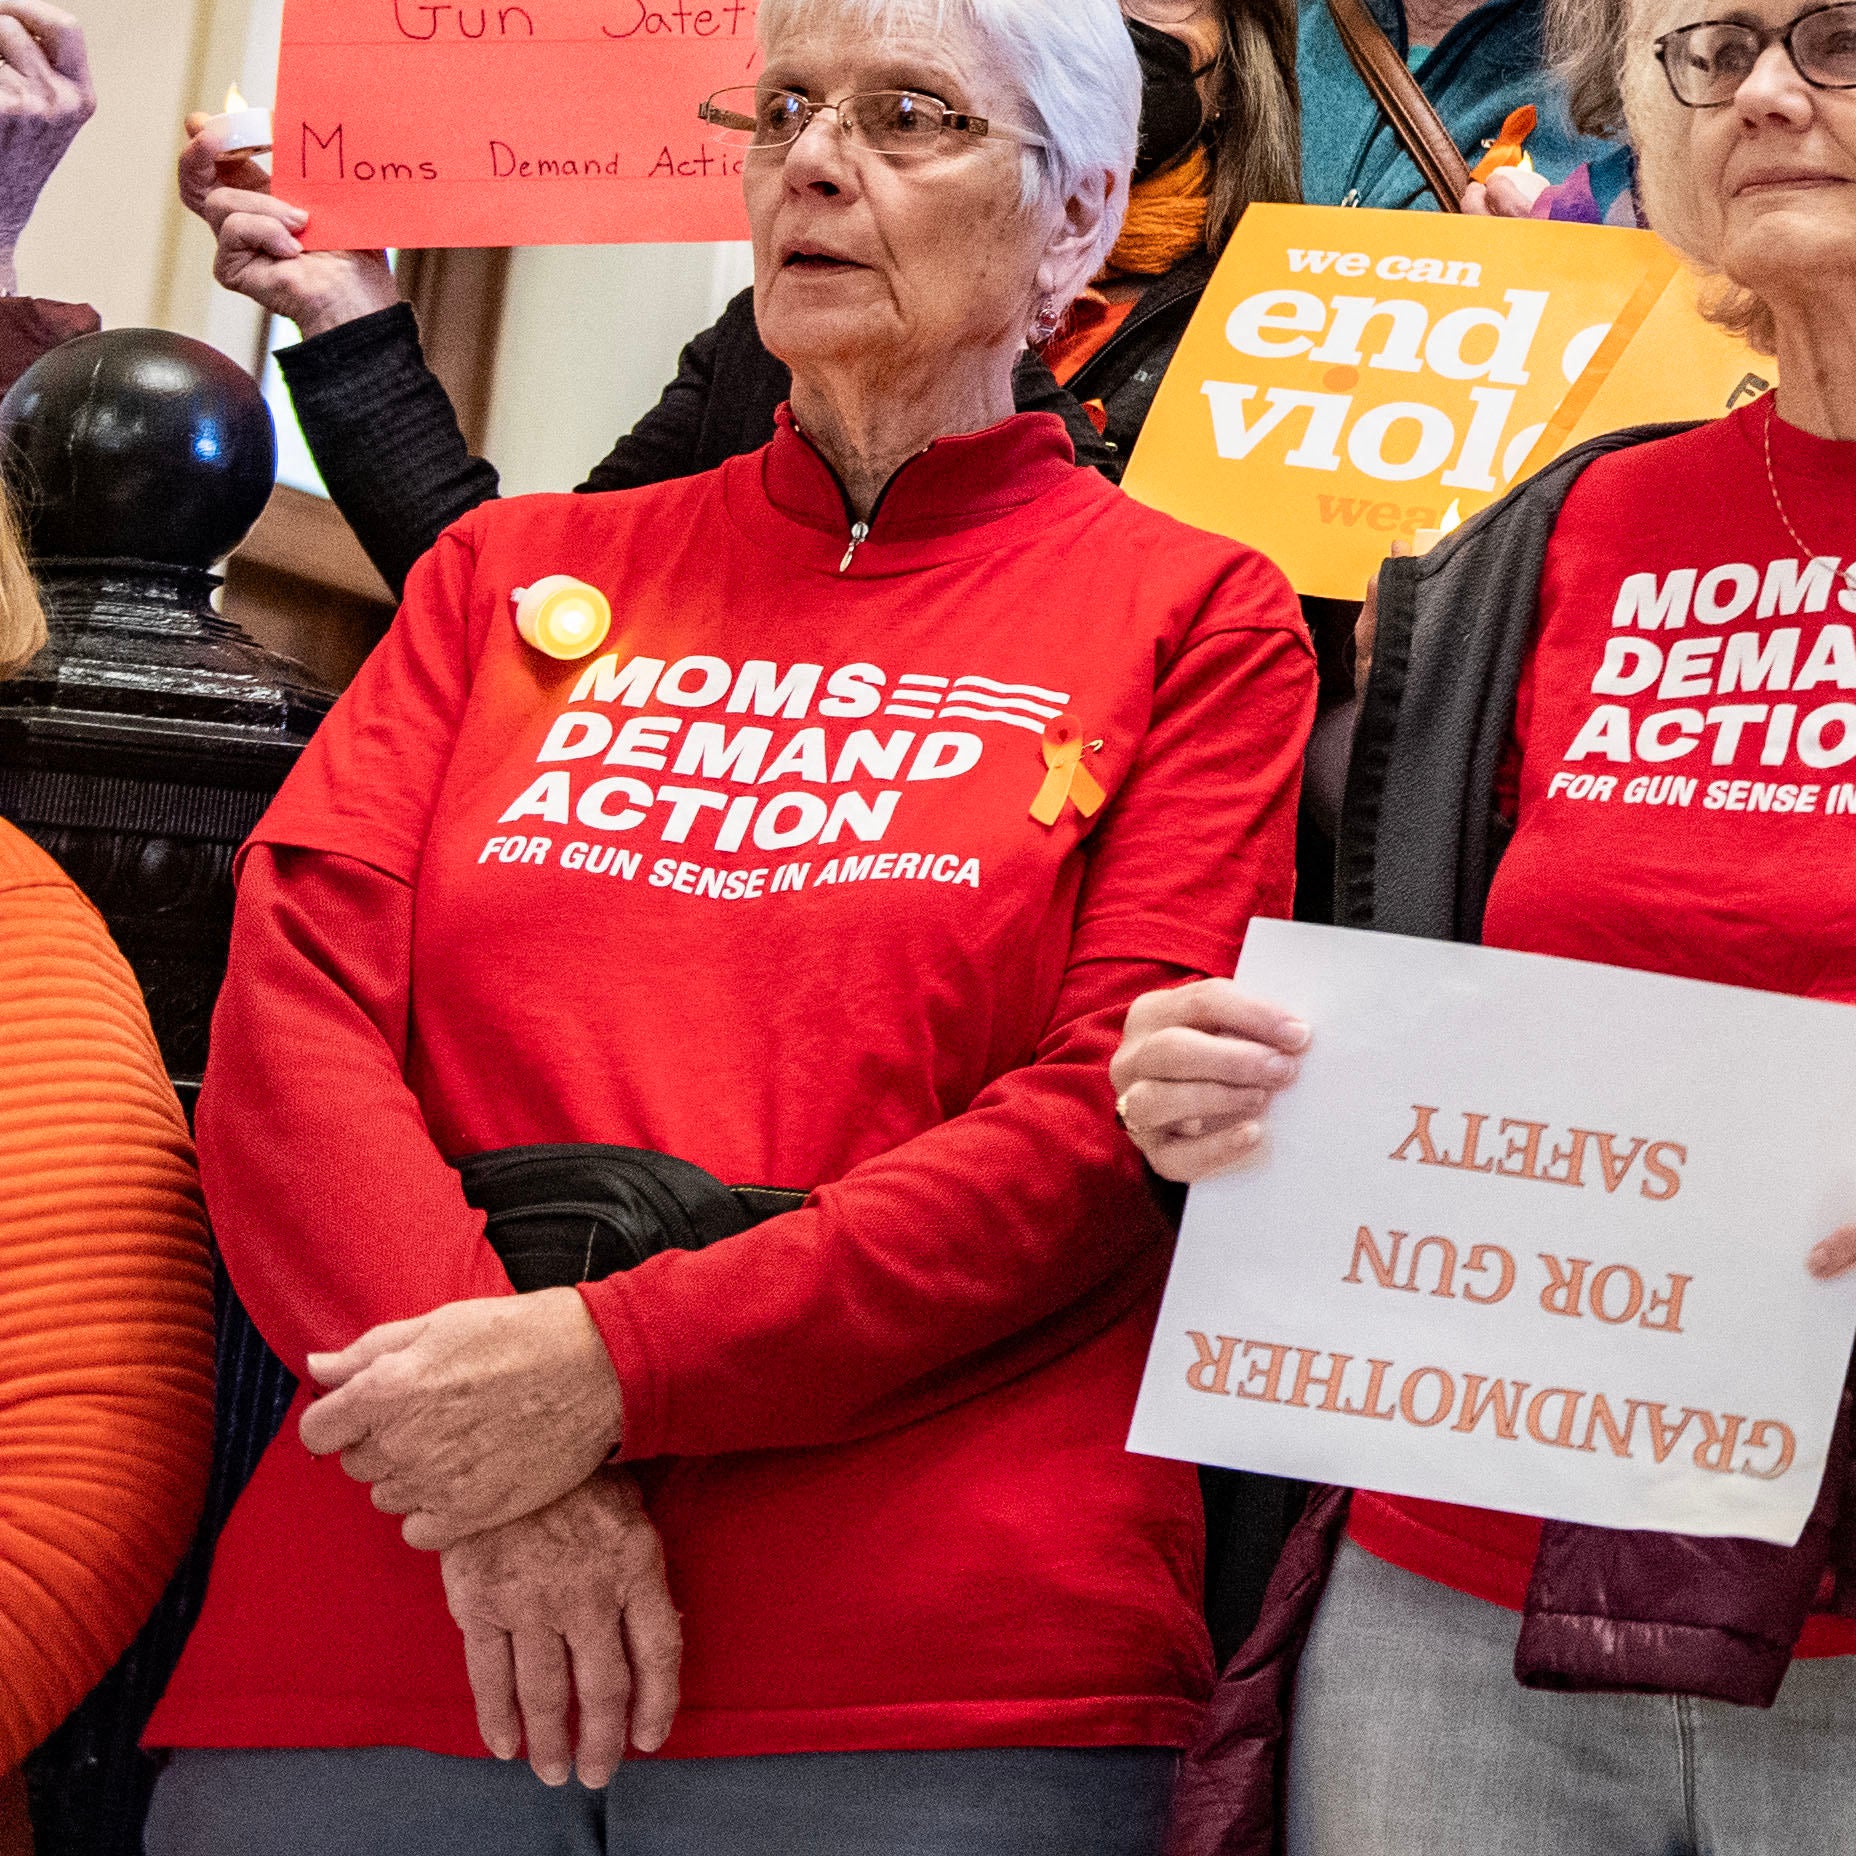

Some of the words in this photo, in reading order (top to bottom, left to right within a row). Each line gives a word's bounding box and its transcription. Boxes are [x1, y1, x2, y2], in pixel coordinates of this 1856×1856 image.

[303, 122, 437, 181] Moms
[490, 140, 619, 177] Demand
[1286, 247, 1369, 278] we
[1375, 254, 1482, 287] can
[1225, 289, 1549, 385] end
[1200, 380, 1548, 492] viol
[569, 652, 886, 721] MOMS
[536, 712, 983, 783] DEMAND
[498, 771, 903, 852] ACTION
[1547, 770, 1614, 802] FOR
[1624, 775, 1697, 808] GUN
[1703, 780, 1818, 815] SENSE
[478, 835, 553, 865] FOR
[561, 842, 642, 880] GUN
[652, 858, 771, 900] SENSE
[770, 862, 811, 893] IN
[812, 853, 981, 888] AMERICA
[1390, 1104, 1688, 1201] SAFETY
[1342, 1226, 1515, 1304] GUN
[1538, 1253, 1693, 1333] FOR
[1185, 1330, 1796, 1481] GRANDMOTHER
